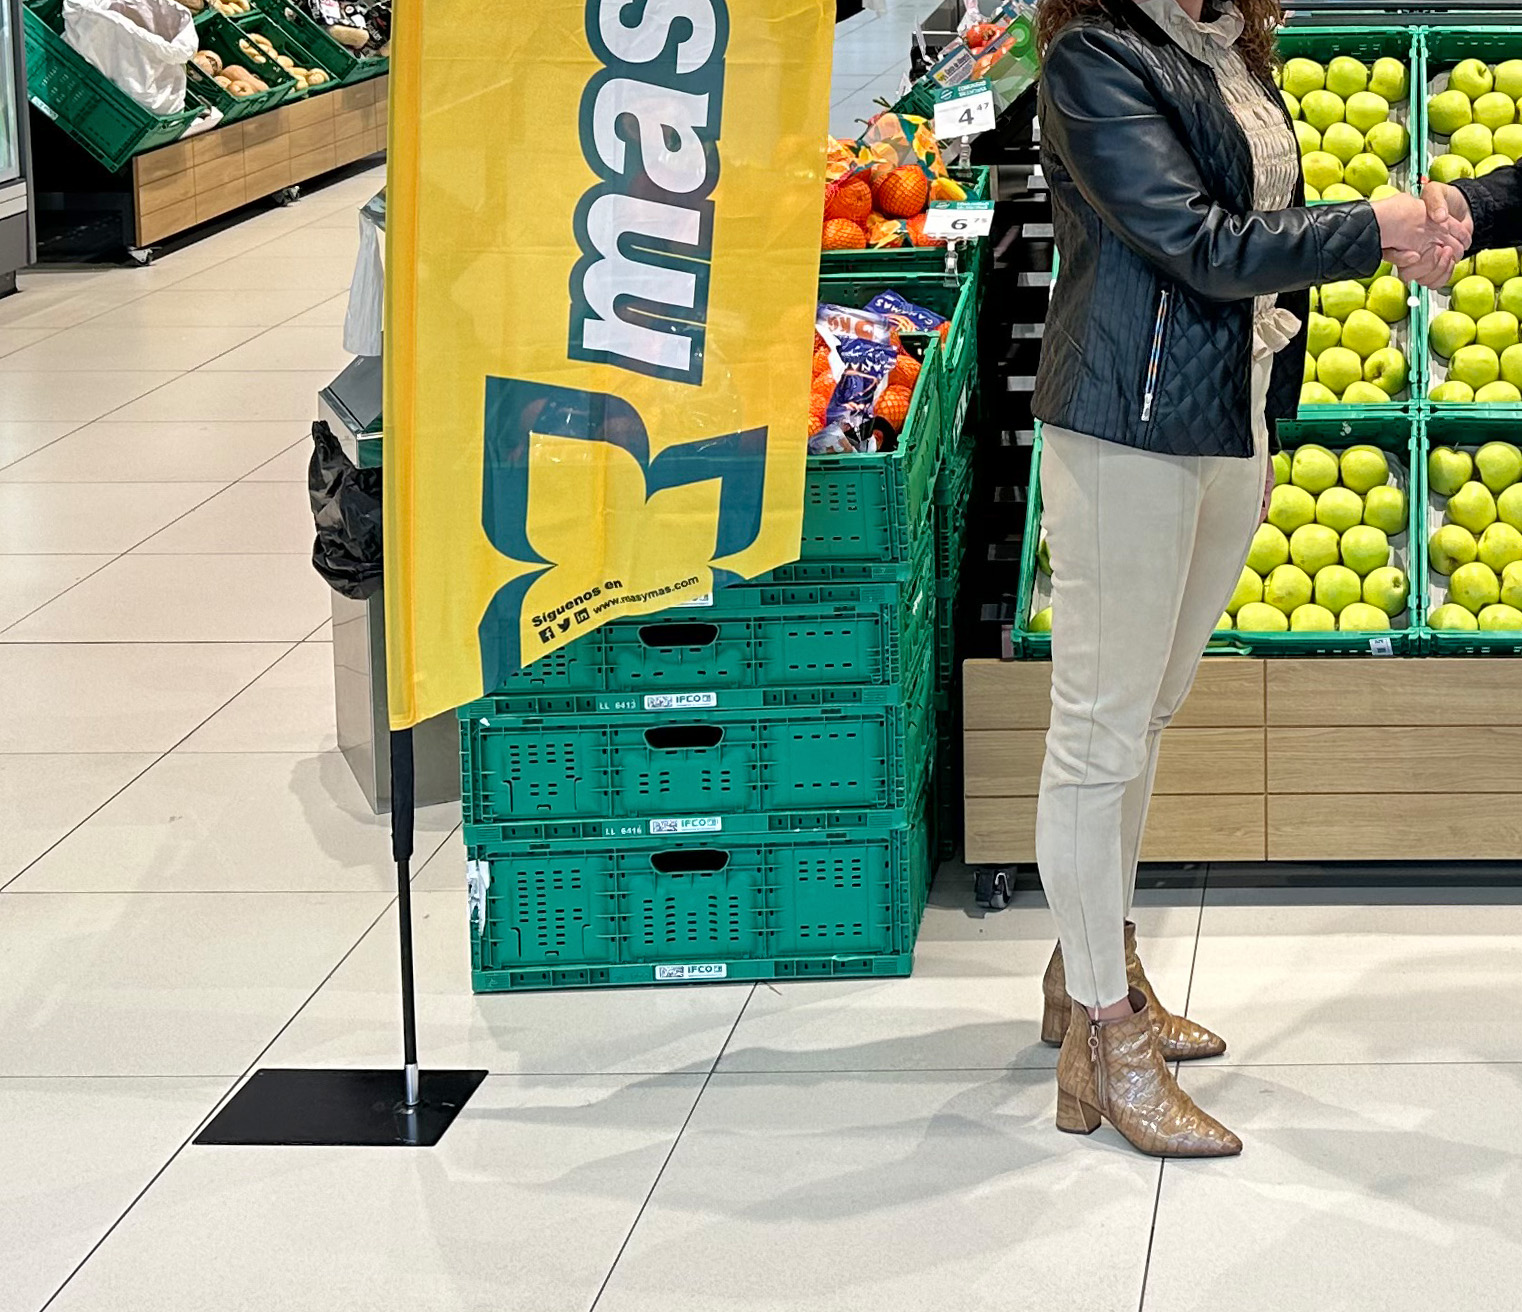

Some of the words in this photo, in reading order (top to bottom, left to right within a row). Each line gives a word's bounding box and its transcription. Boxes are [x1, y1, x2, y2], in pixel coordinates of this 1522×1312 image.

[958, 108, 975, 125] 4
[951, 218, 968, 230] 6
[592, 574, 700, 615] www.masymas.com
[531, 586, 602, 628] Síguenos
[604, 578, 623, 591] en
[675, 694, 701, 704] IFCO
[599, 702, 611, 710] LL
[681, 819, 706, 828] IFCO
[605, 828, 616, 836] LL
[687, 965, 713, 974] IFCO
